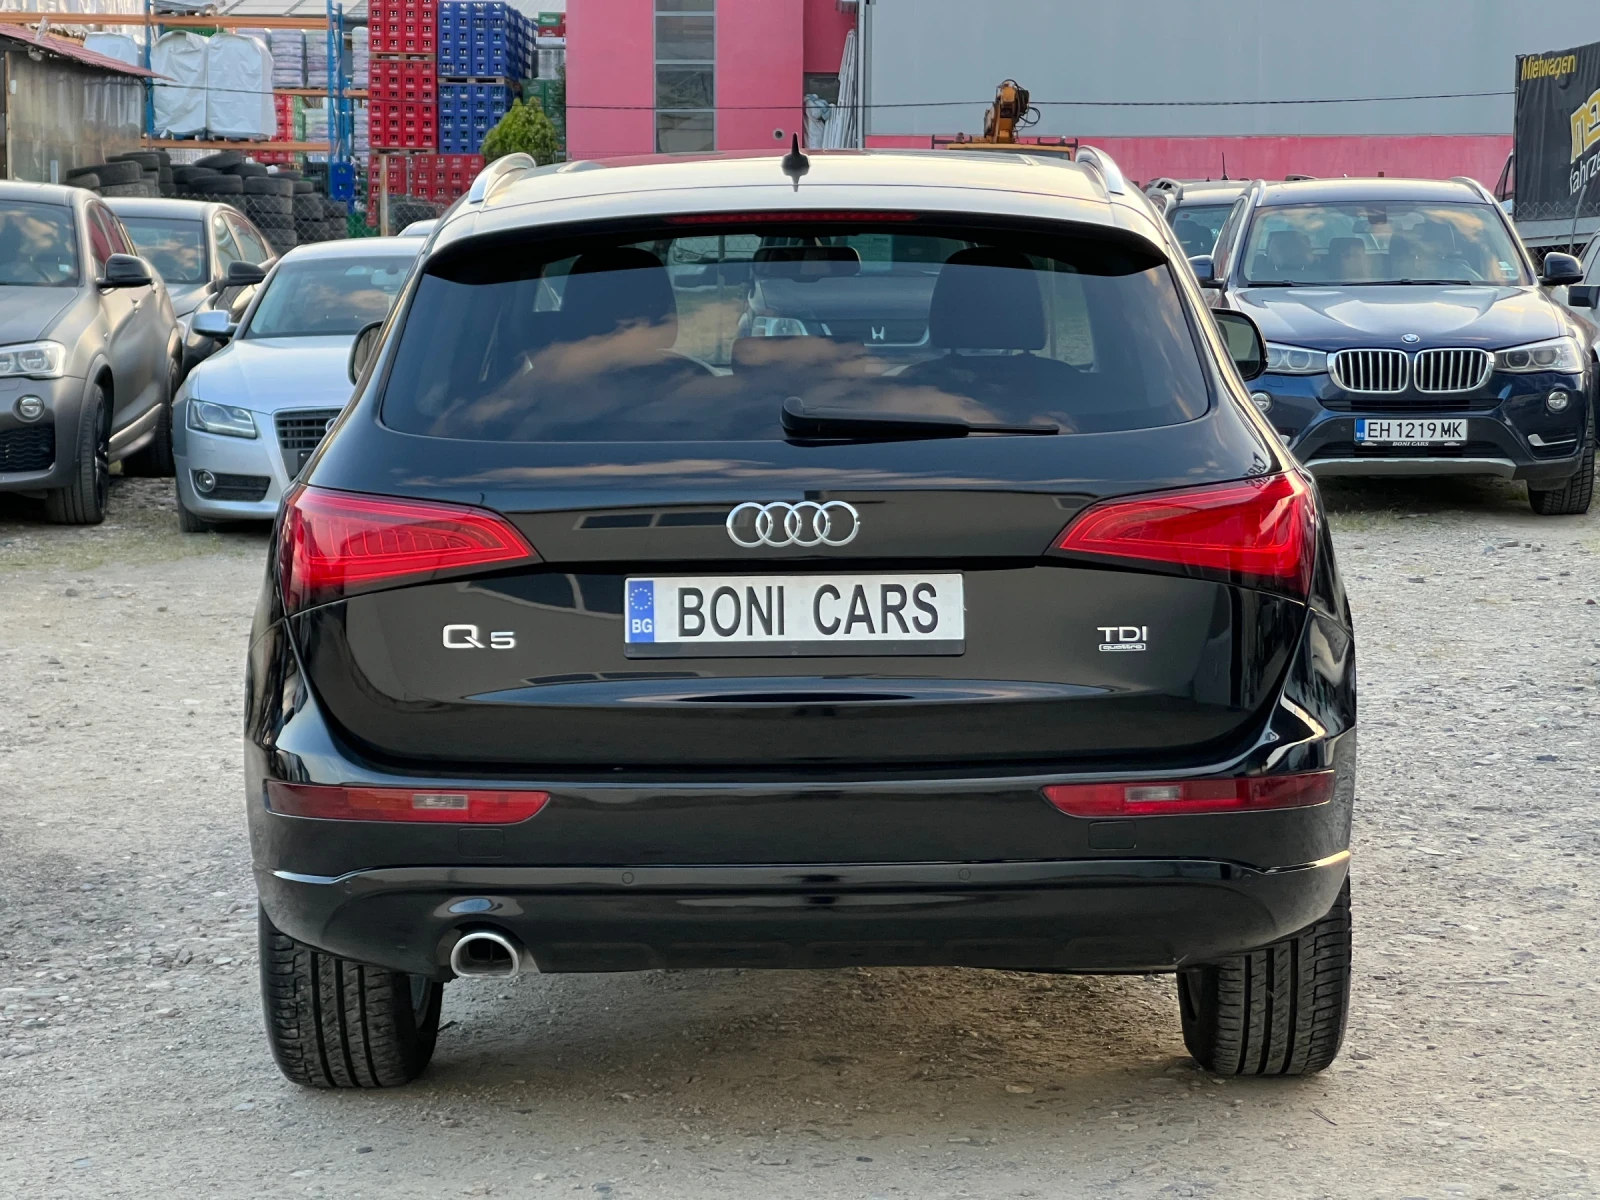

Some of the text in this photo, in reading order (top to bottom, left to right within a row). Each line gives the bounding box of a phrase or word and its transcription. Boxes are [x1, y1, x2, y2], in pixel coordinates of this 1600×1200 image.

[1521, 54, 1576, 81] Mietwagen
[1368, 421, 1462, 438] EH 1219 MK
[677, 582, 939, 638] BONI CARS
[631, 618, 653, 633] BG
[1096, 626, 1147, 642] TDI
